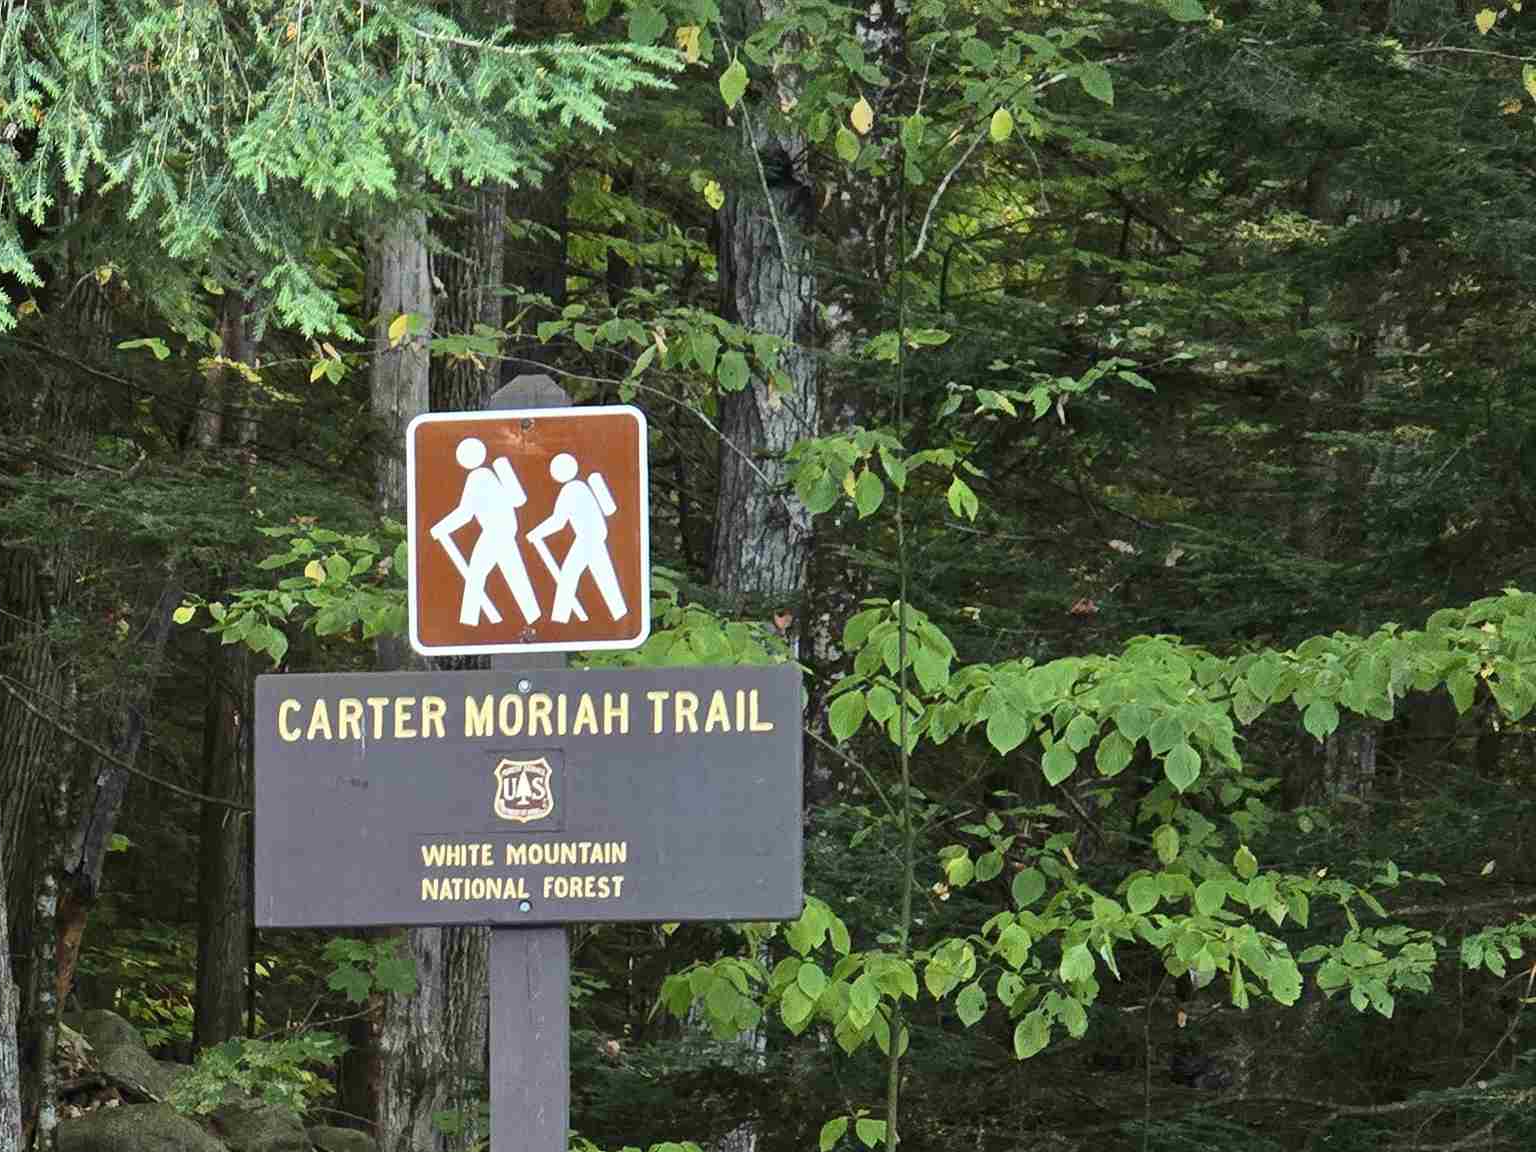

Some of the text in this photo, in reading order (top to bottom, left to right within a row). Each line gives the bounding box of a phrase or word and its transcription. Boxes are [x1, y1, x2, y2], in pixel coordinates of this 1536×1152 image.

[277, 688, 774, 742] CARTER MORIAH TRAIL
[421, 841, 627, 867] WHITE MOUNTAIN
[421, 875, 624, 900] NATIONAL FOREST
